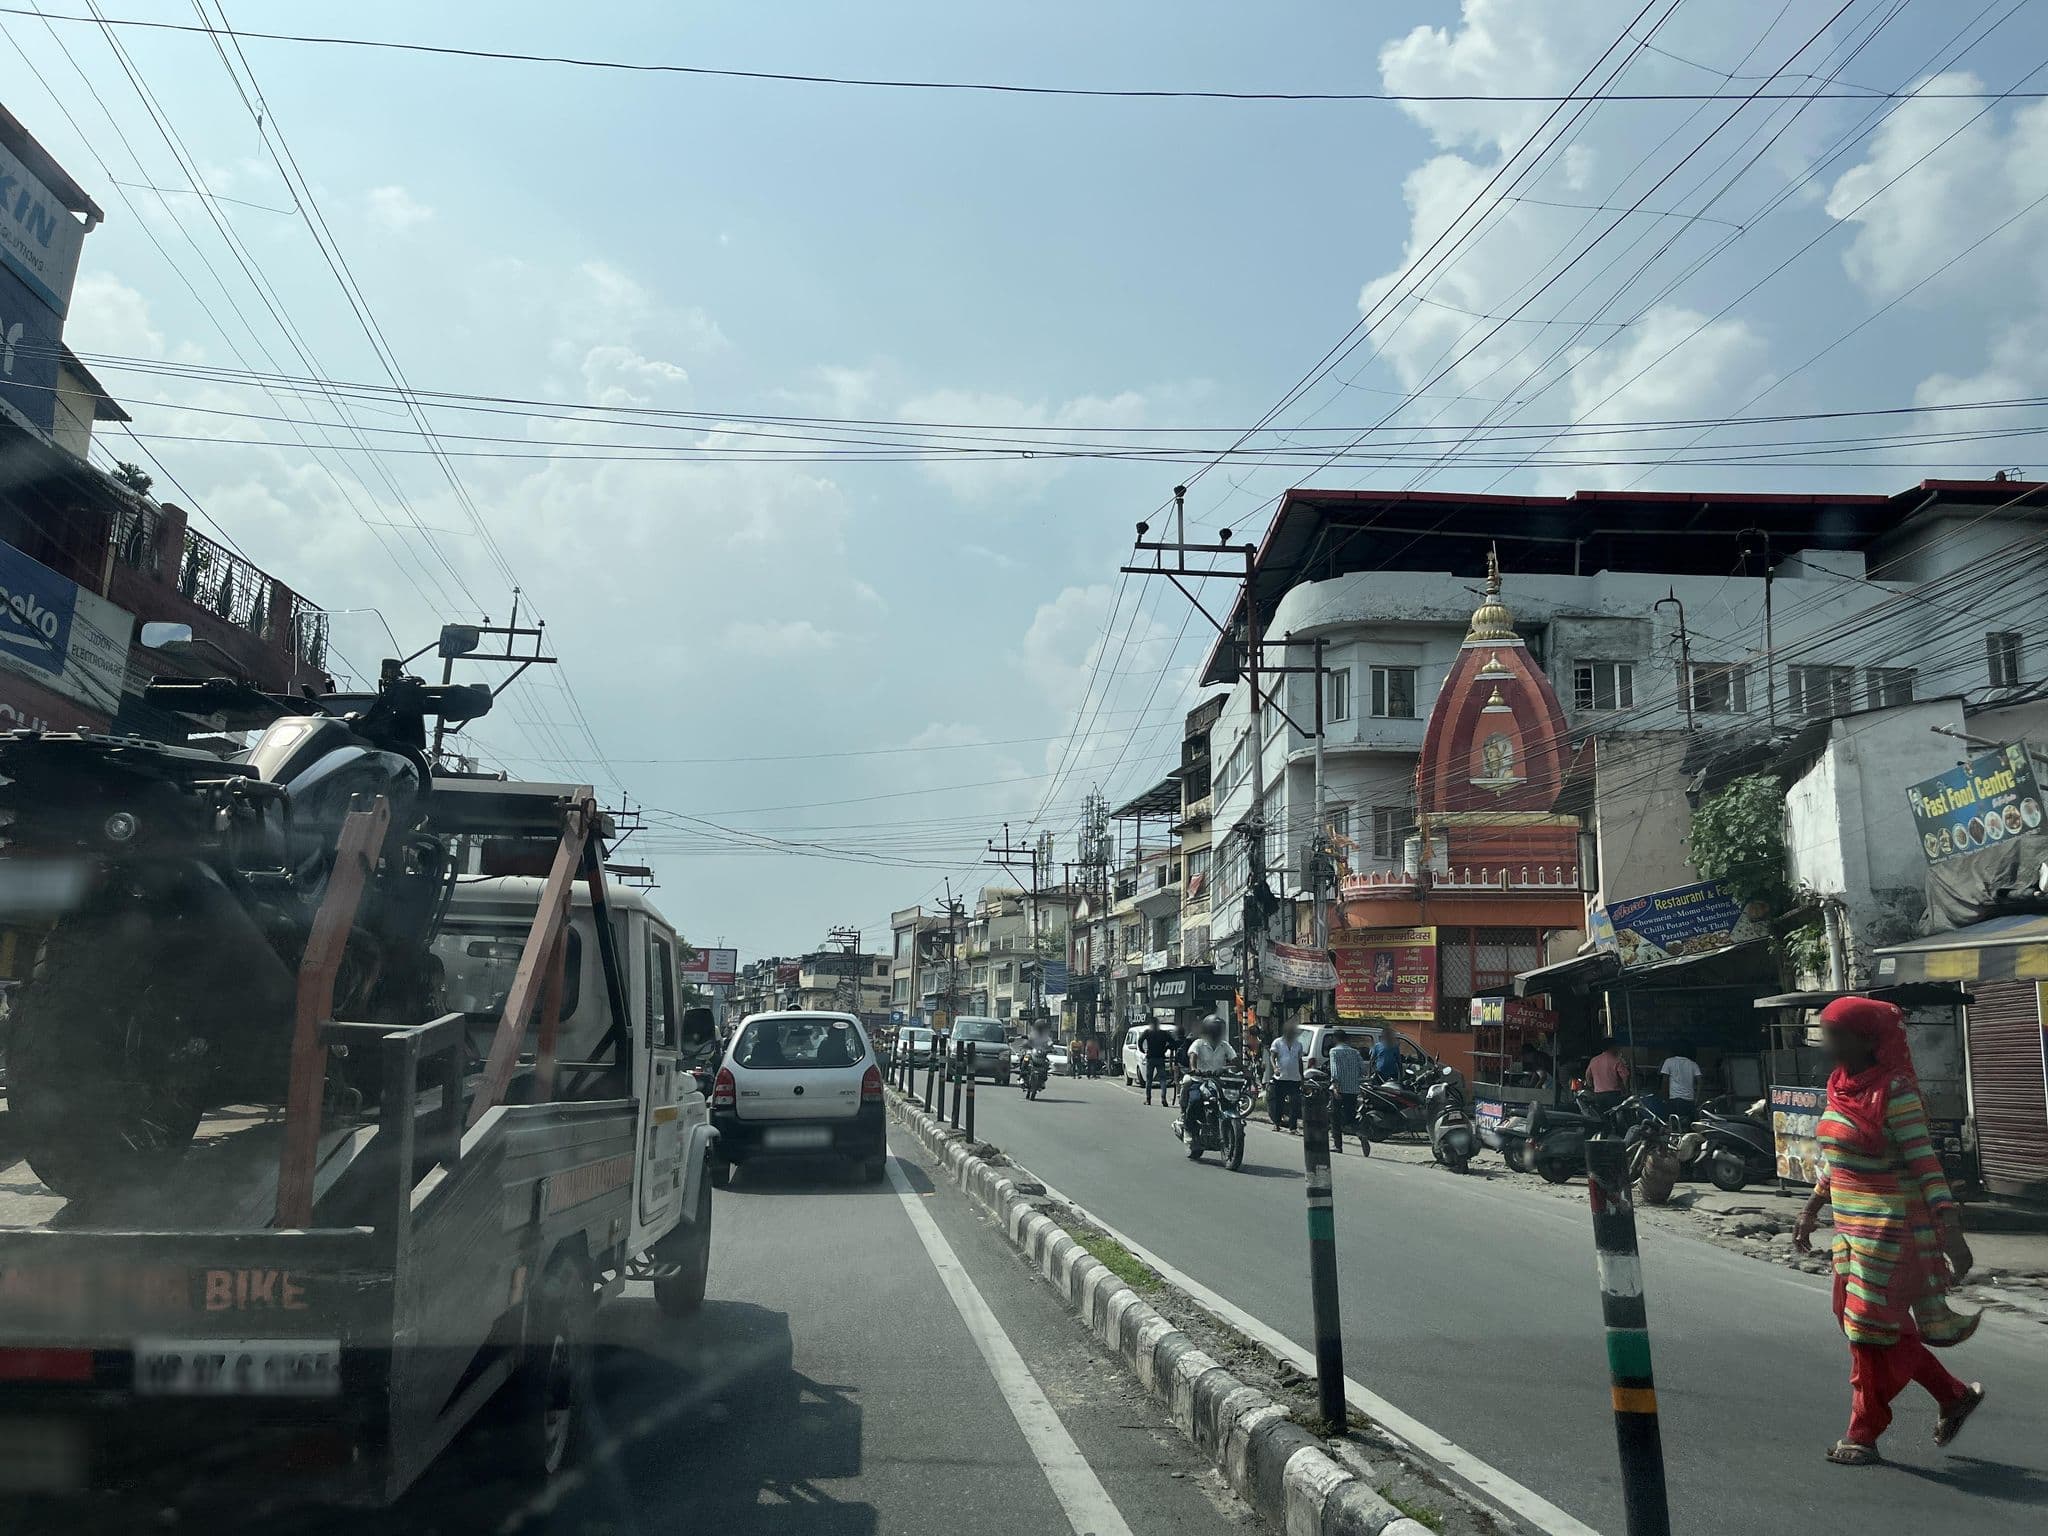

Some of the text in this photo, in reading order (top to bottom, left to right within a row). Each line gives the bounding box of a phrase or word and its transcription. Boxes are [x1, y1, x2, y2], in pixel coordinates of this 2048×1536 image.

[1922, 792, 1949, 818] Fast
[1946, 780, 1976, 810] Food
[1974, 770, 2016, 799] Centre
[1655, 890, 1705, 910] Restaurant
[1632, 902, 1731, 927] Chowmein Momo Spring
[1643, 926, 1665, 935] Chilli
[1666, 921, 1690, 930] Potato
[1660, 921, 1729, 941] Paratha Veg Thali
[1160, 980, 1186, 996] LOTTO
[1505, 1014, 1526, 1025] Fast
[1530, 1018, 1554, 1029] Food
[1517, 1007, 1545, 1019] Arora
[1771, 1089, 1791, 1105] FAST
[1791, 1091, 1817, 1108] FOOD
[205, 1269, 308, 1311] BIKE
